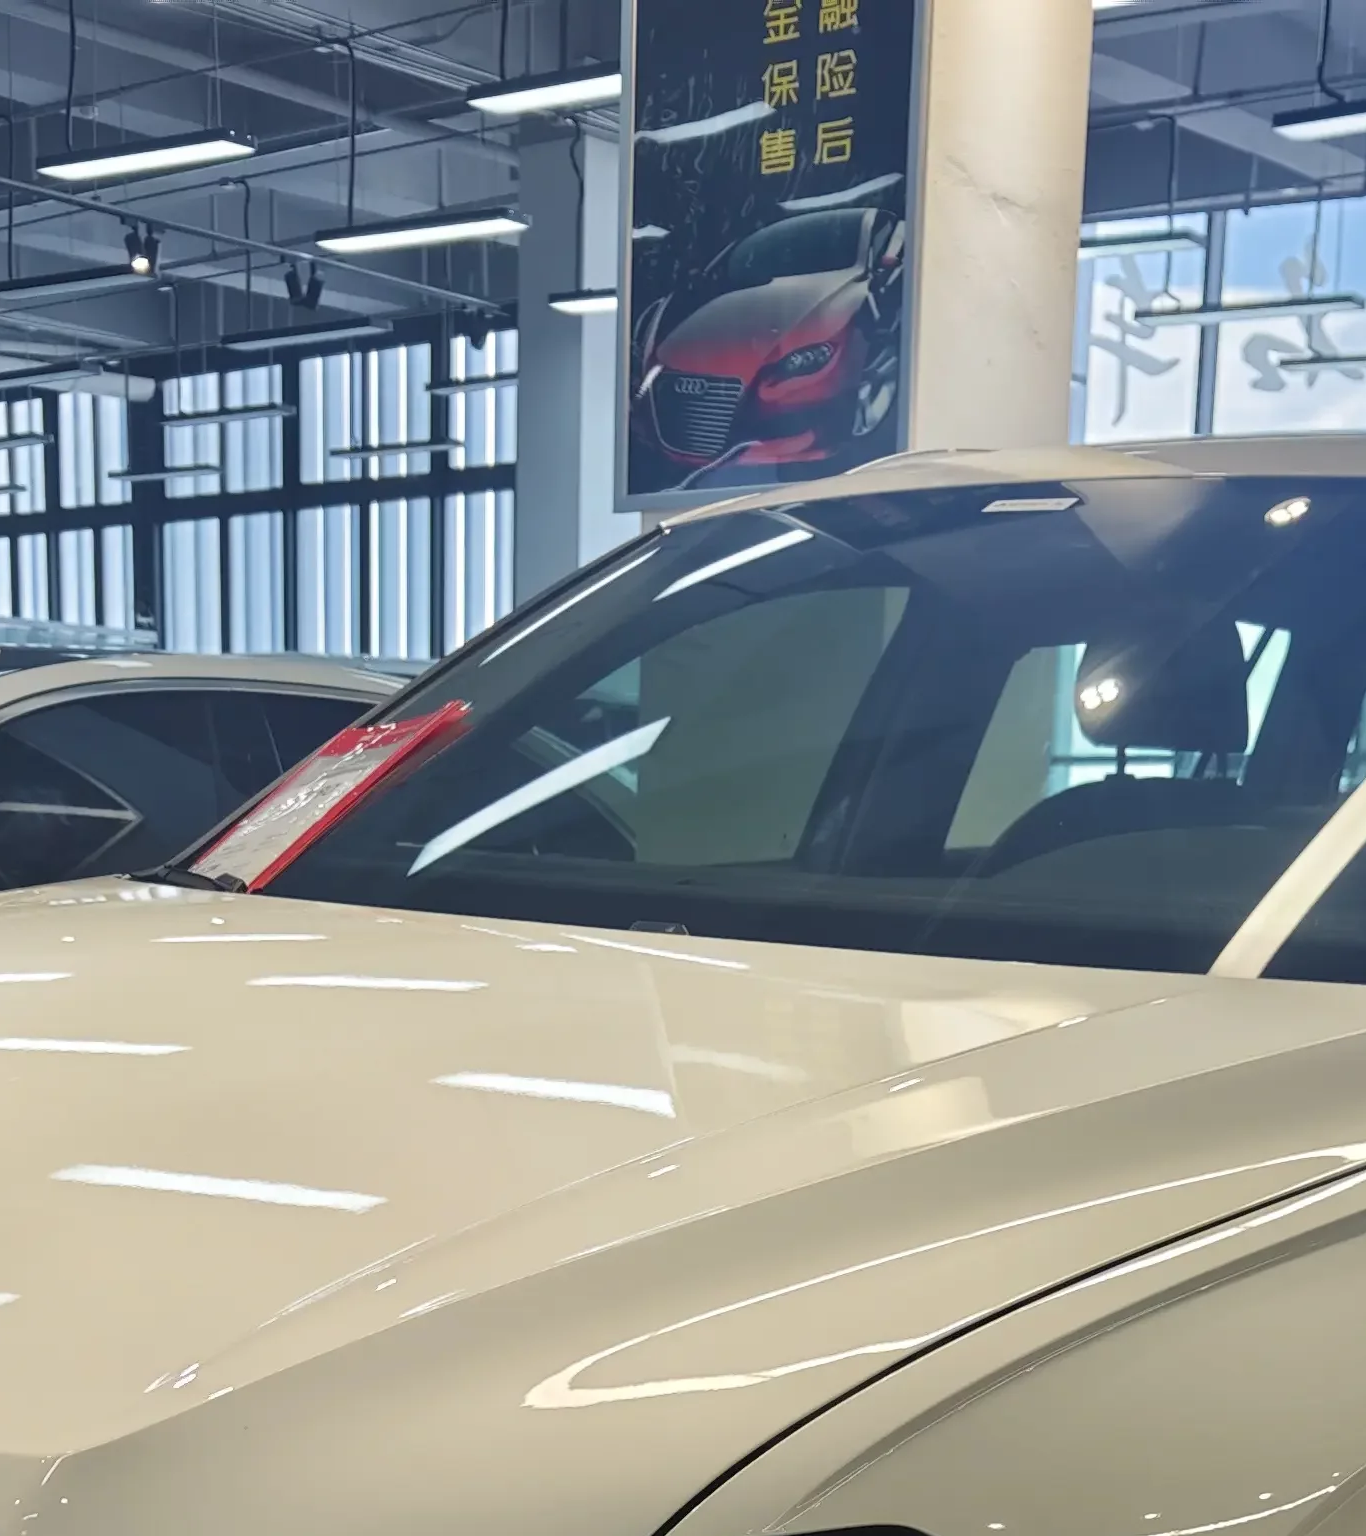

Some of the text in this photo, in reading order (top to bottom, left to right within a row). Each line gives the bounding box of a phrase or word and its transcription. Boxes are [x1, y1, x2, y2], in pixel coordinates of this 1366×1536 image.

[762, 0, 859, 44] 金融
[761, 48, 859, 109] 保险
[758, 115, 856, 176] 售后
